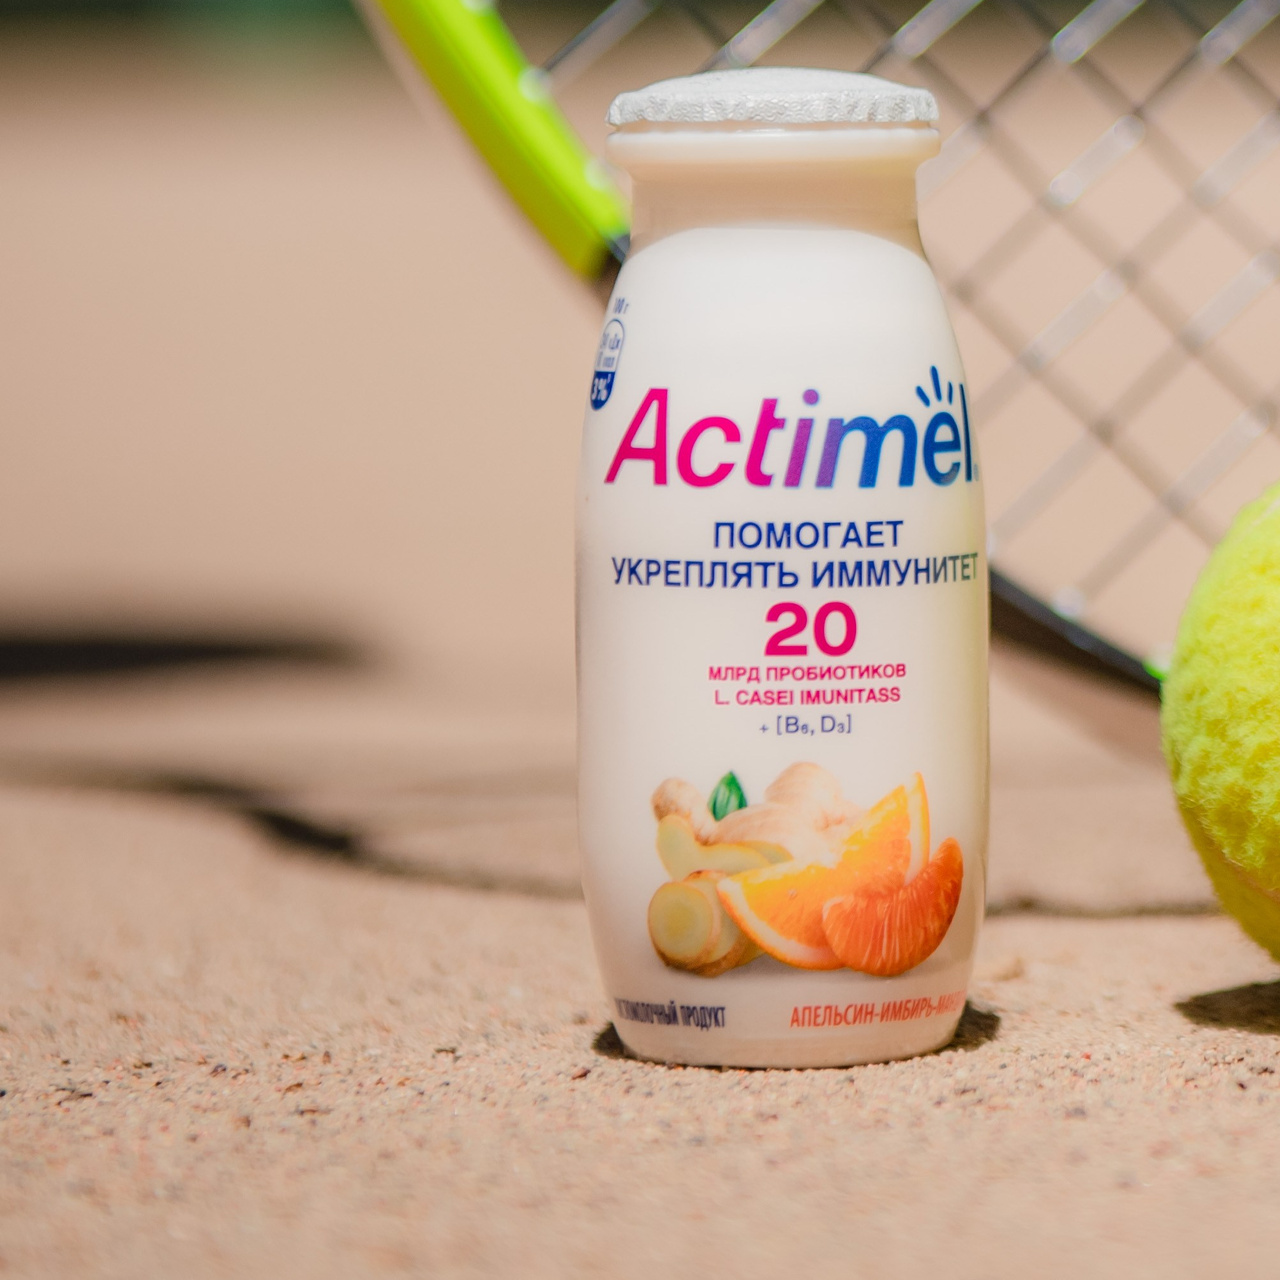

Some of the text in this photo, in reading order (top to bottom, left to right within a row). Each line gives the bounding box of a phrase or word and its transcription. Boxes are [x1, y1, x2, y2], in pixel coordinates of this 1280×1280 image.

[603, 383, 972, 488] Actimel
[714, 520, 904, 549] ПОМОГАЕТ
[612, 552, 979, 588] УКРЕПЛЯТЬ ИММУНИТЕТ
[764, 601, 857, 657] 20
[708, 663, 906, 684] МЛРД ПРОБИОТИКОВ
[715, 686, 901, 706] L. CASEI IMUNITASS
[680, 1005, 725, 1032] ПРОДУКТ
